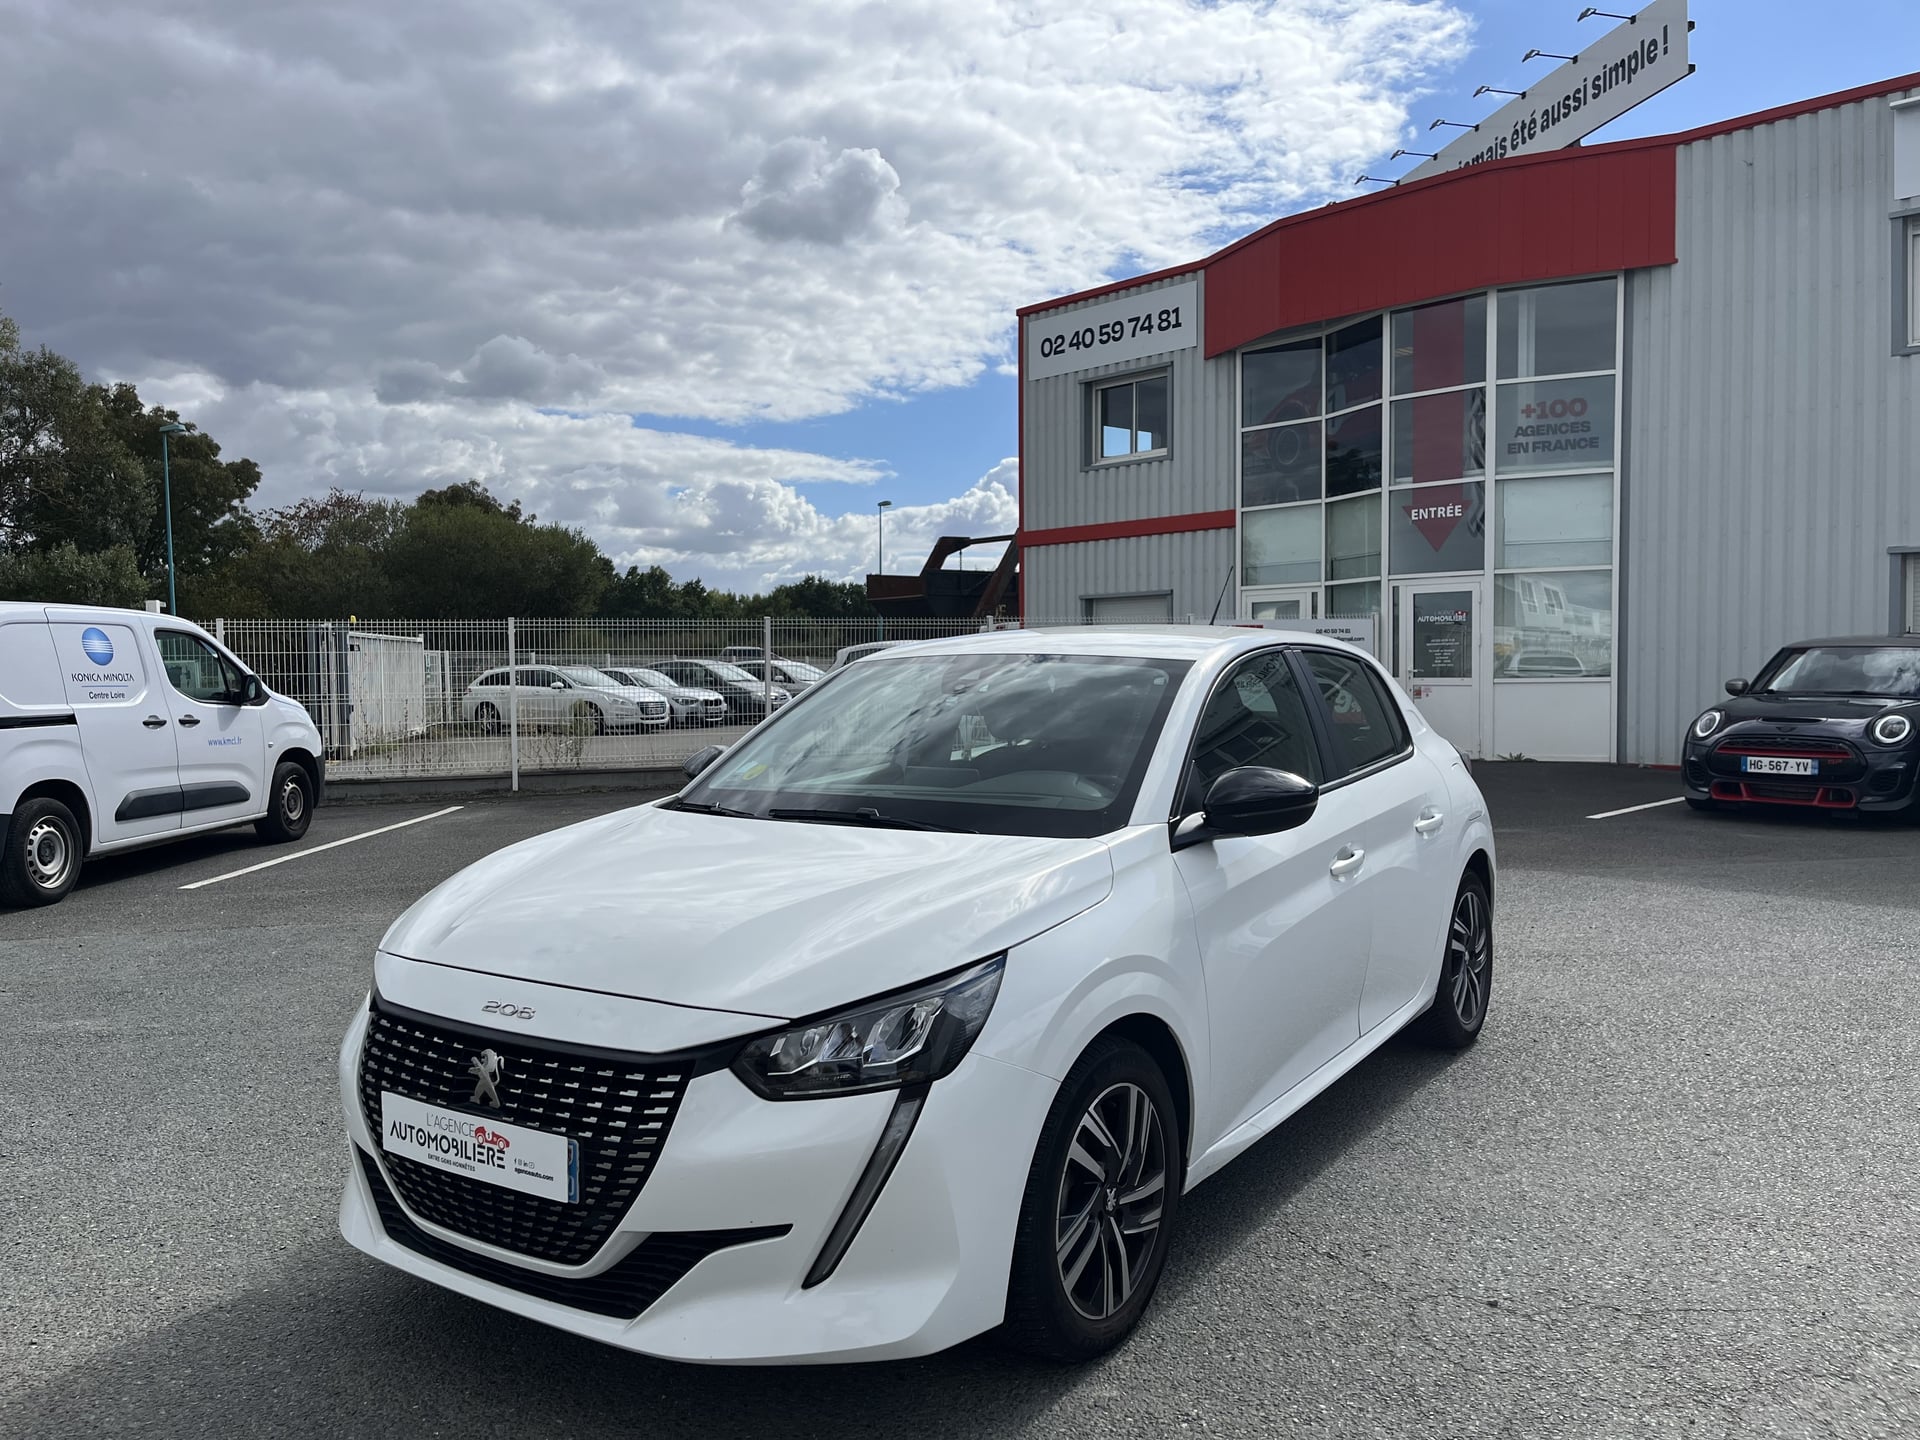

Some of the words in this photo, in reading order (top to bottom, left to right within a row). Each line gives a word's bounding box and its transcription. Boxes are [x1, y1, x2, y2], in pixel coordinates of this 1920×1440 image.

[1511, 109, 1537, 151] été
[1540, 78, 1588, 136] aussi
[1591, 38, 1658, 101] simple
[1040, 334, 1066, 358] 02
[1068, 327, 1095, 351] 40
[1098, 320, 1125, 345] 59
[1127, 313, 1154, 338] 74
[1157, 306, 1183, 331] 81
[1520, 397, 1588, 420] +100
[1514, 421, 1591, 438] AGENCES
[1507, 441, 1530, 455] EN
[1532, 436, 1600, 453] FRANCE
[1411, 503, 1463, 521] ENTRÉE
[71, 672, 102, 682] KONICA
[103, 672, 135, 682] MINOLTA
[88, 691, 109, 700] Centre
[110, 691, 126, 699] Loire
[1749, 759, 1809, 773] HG-567-YV
[426, 1112, 475, 1138] L'AGENCE
